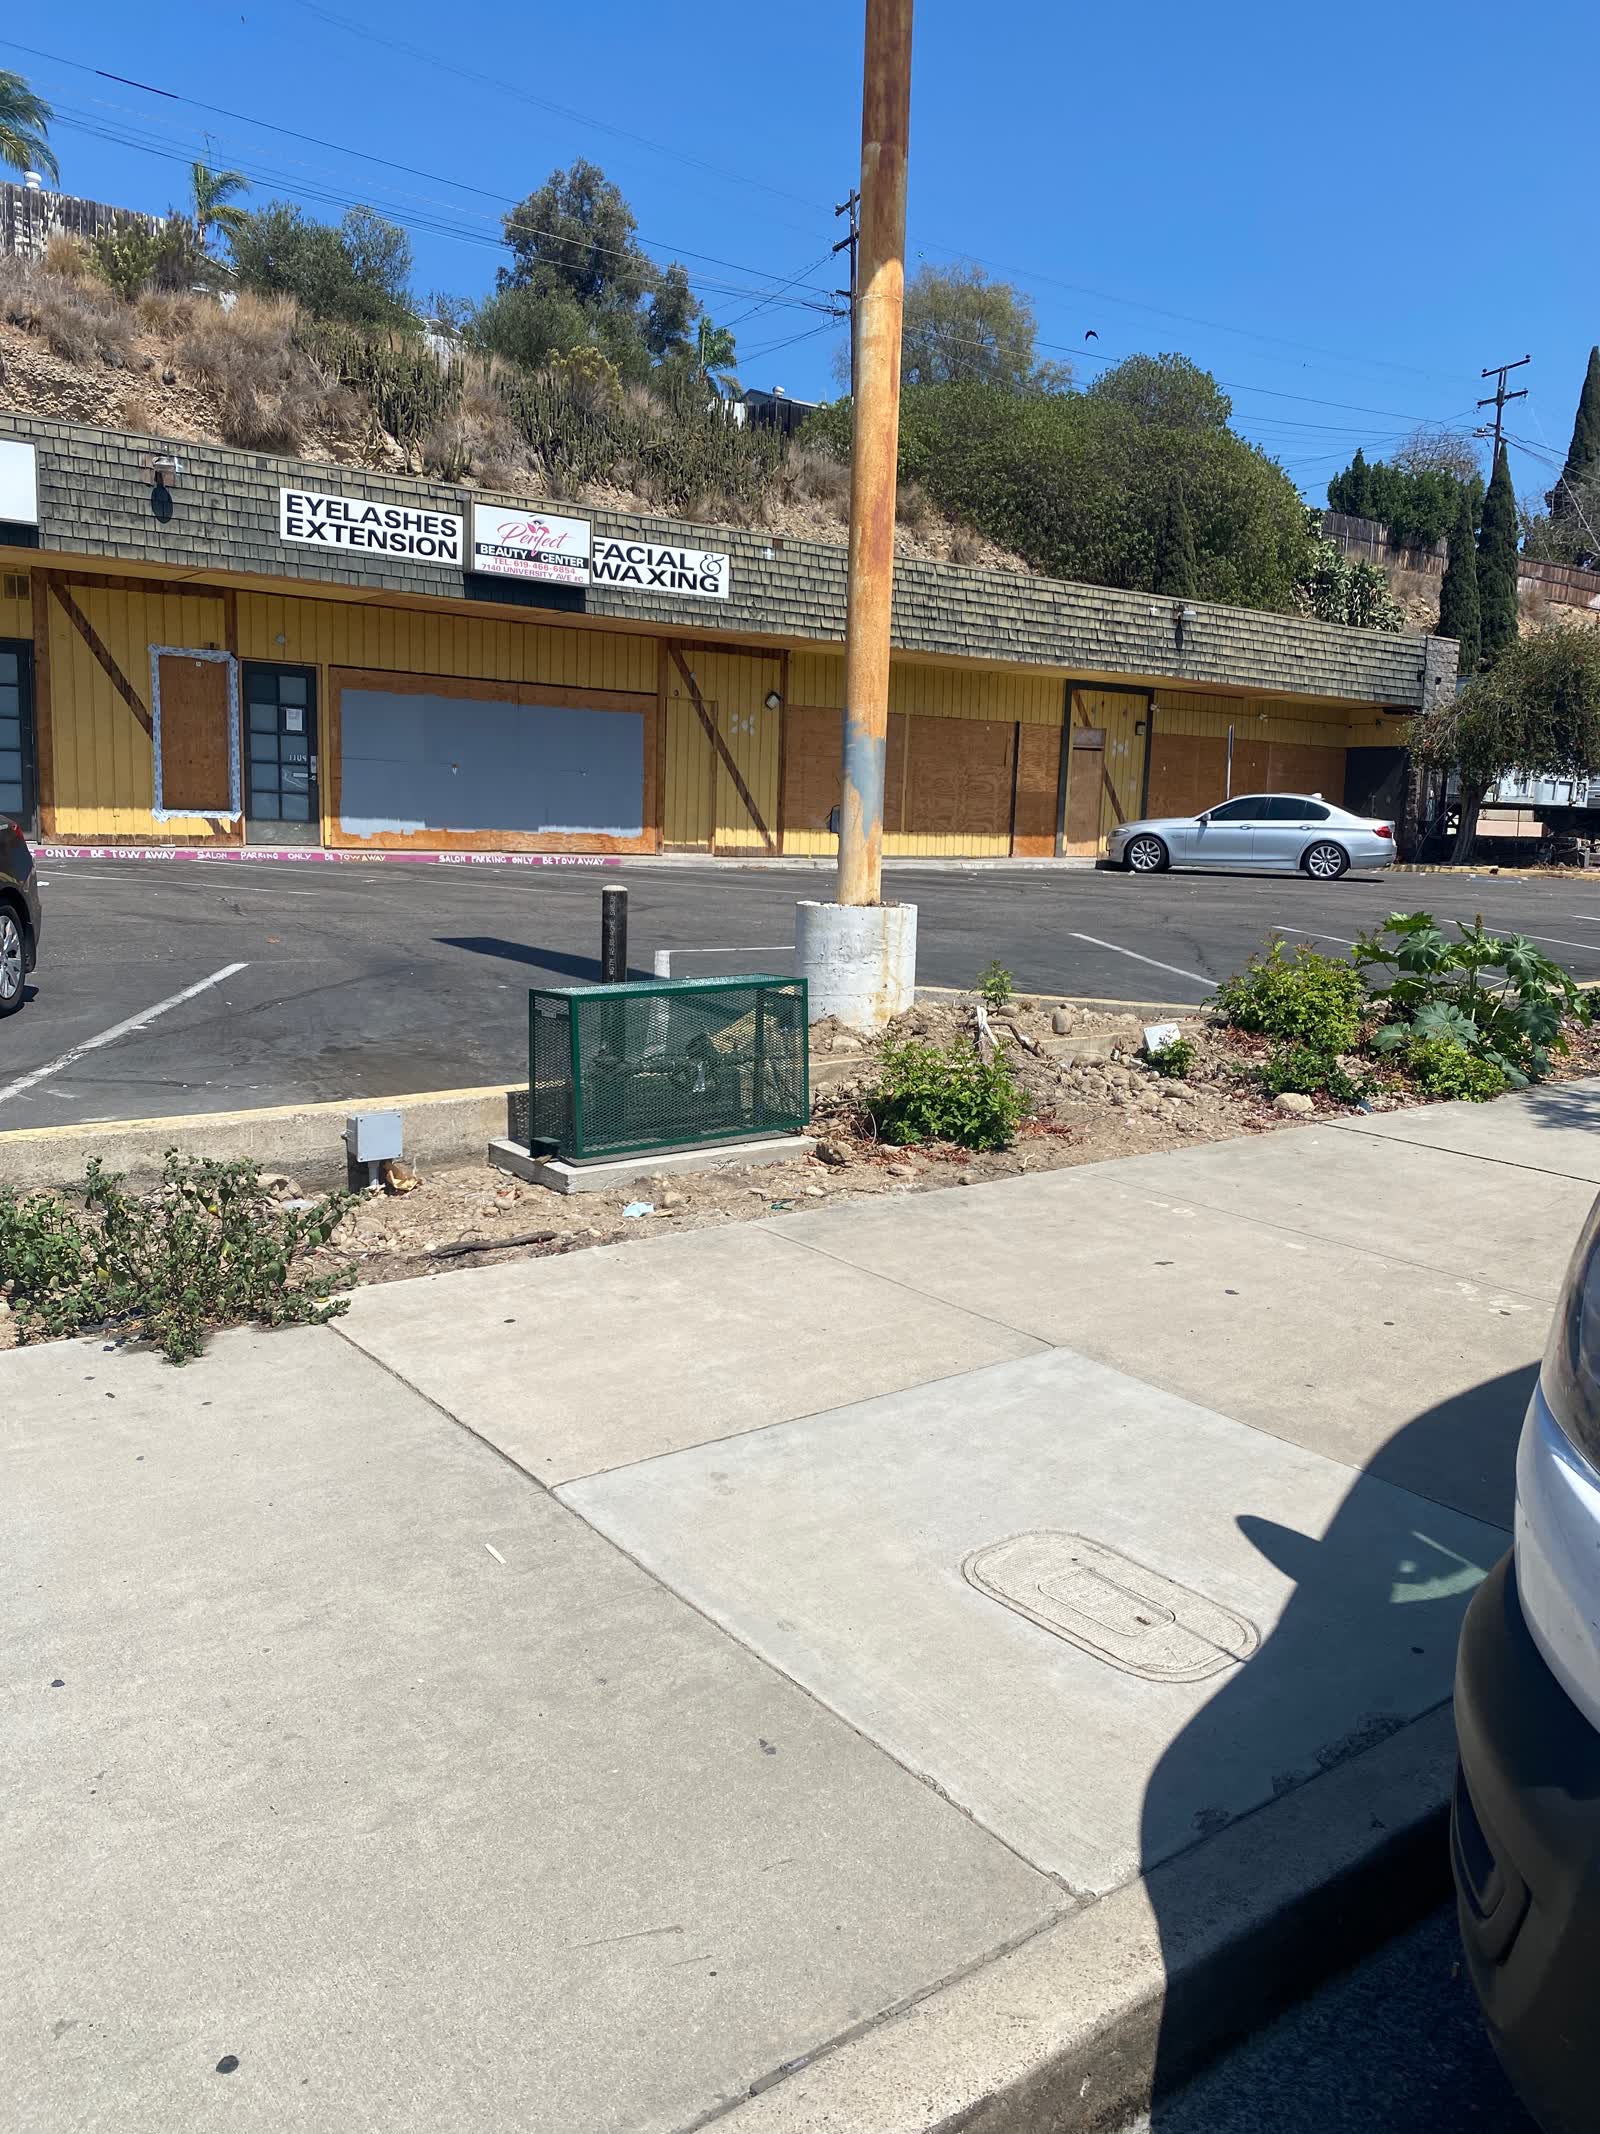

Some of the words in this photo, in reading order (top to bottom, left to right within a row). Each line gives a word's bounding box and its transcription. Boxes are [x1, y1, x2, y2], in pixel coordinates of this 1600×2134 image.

[287, 493, 457, 538] EYELASHES
[286, 516, 458, 560] EXTENSION
[497, 521, 575, 556] Perfect
[480, 544, 529, 559] BEAUTY
[540, 552, 584, 567] CENTER
[593, 541, 695, 571] FACIAL
[699, 553, 725, 576] &
[481, 563, 502, 572] 7140
[503, 566, 553, 578] UNIVERSITY
[555, 572, 572, 581] AVE
[592, 560, 719, 593] WAXING
[45, 849, 79, 858] ONLY
[90, 849, 106, 858] BE
[240, 851, 279, 860] PARKING
[288, 852, 312, 860] ONLY
[438, 854, 466, 863] SALON
[471, 855, 507, 863] PARKING
[512, 856, 534, 864] ONLY
